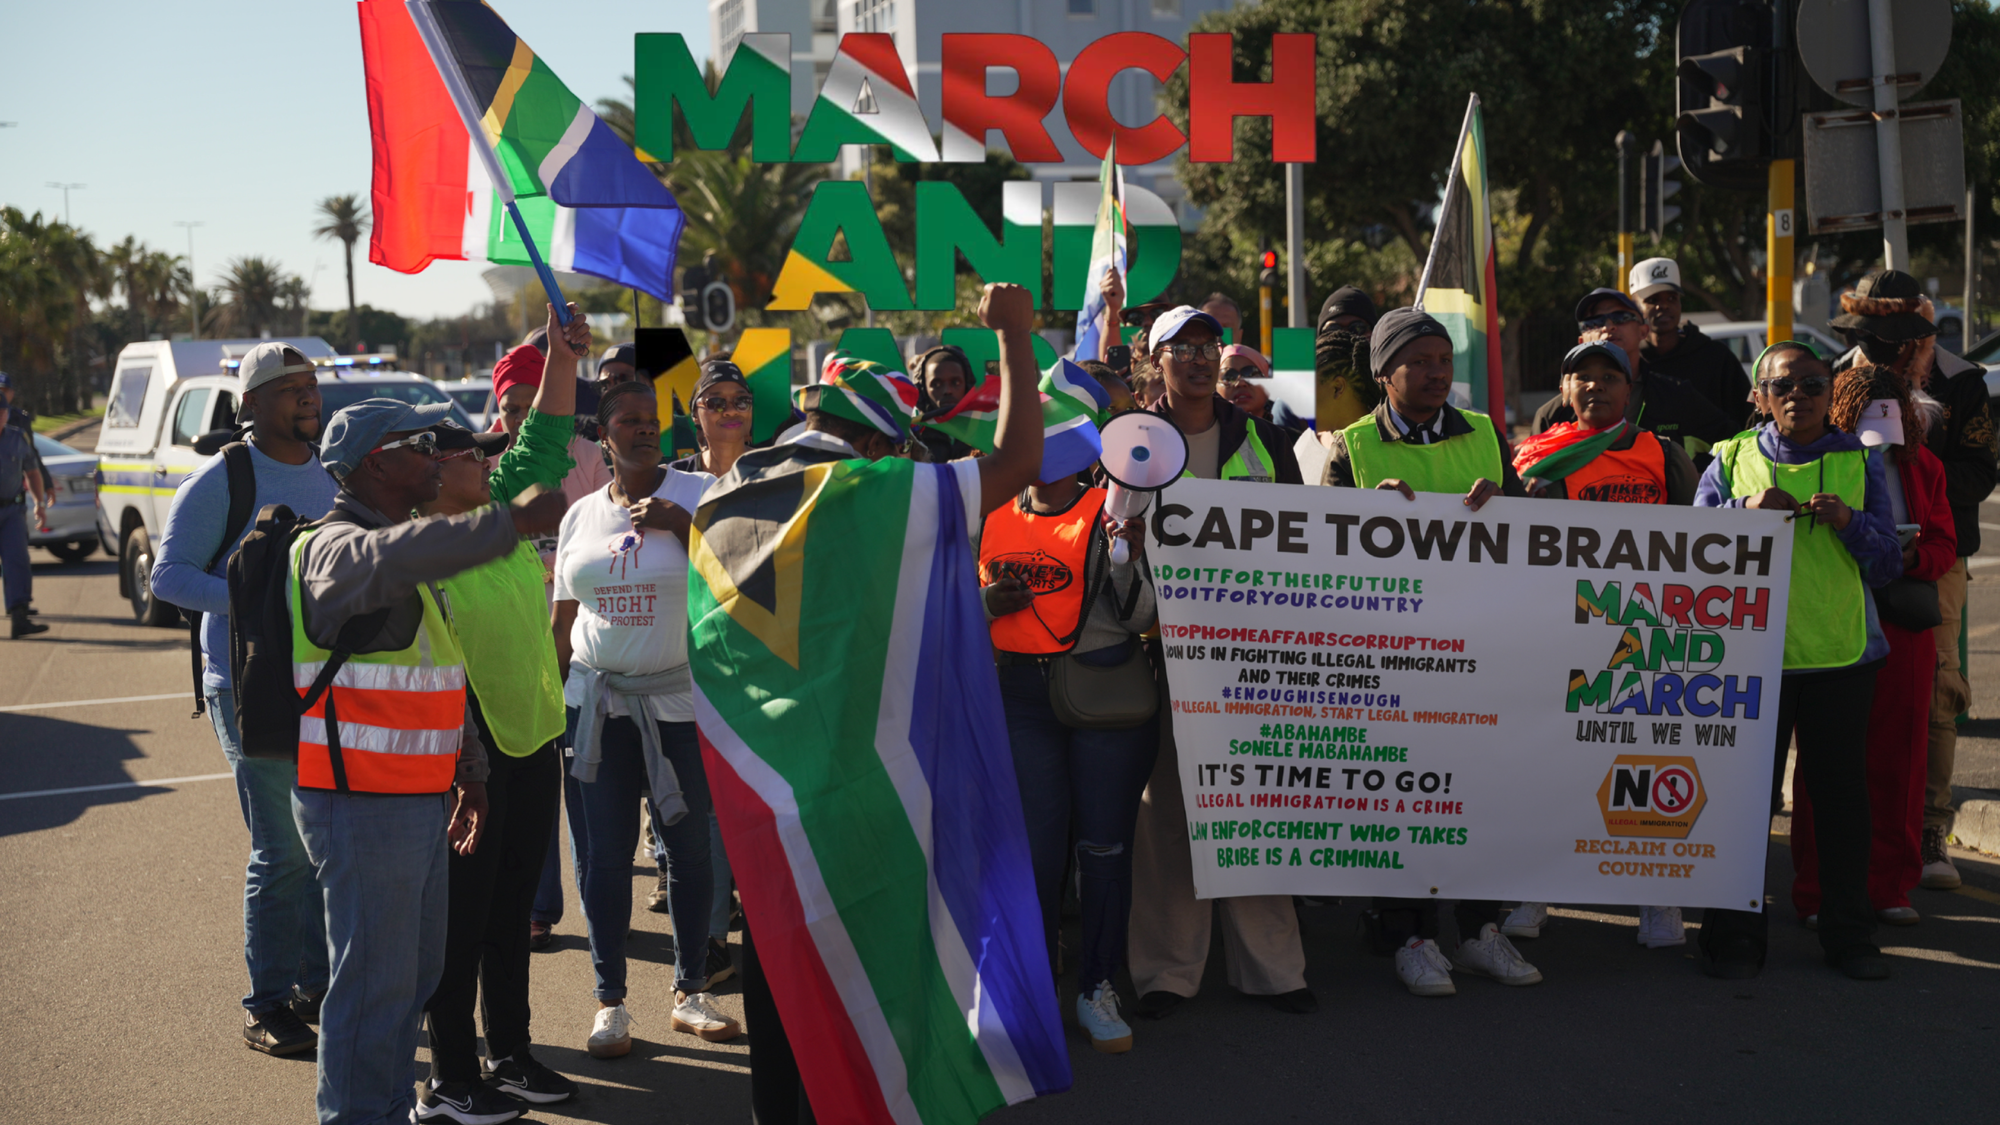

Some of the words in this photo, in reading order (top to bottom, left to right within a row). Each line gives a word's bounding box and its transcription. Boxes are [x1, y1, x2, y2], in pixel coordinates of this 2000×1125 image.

[1781, 213, 1790, 232] 8
[1652, 265, 1668, 278] Cal
[1583, 484, 1659, 503] MIKE'S
[1151, 503, 1309, 553] CAPE
[1325, 513, 1510, 564] TOWN
[1527, 524, 1774, 576] BRANCH
[593, 584, 632, 595] DEFEND
[635, 584, 656, 592] THE
[1153, 564, 1423, 594] #DOITFORTHEIRFUTURE
[597, 595, 657, 613] RIGHT
[1158, 584, 1423, 613] #DOITFORYOURCOUNTRY
[1575, 580, 1770, 631] MARCH
[610, 615, 655, 626] PROTEST
[1187, 646, 1205, 660] US
[1211, 647, 1227, 661] IN
[1231, 648, 1307, 665] FIGHTING
[1312, 652, 1375, 669] ILLEGAL
[1381, 656, 1477, 673] IMMIGRANTS
[1607, 627, 1725, 672] AND
[1238, 668, 1270, 684] AND
[1276, 671, 1320, 687] THEIR
[1326, 673, 1380, 689] CRIMES
[1222, 686, 1400, 708] #ENOUGHISENOUGH
[1565, 669, 1762, 719] MARCH
[1225, 702, 1317, 719] IMMIGRATION,
[1321, 707, 1364, 720] START
[1368, 709, 1409, 722] LEGAL
[1413, 711, 1498, 726] IMMIGRATION
[1260, 723, 1367, 743] #ABAHAMBE
[1576, 720, 1637, 743] UNTIL
[1652, 723, 1682, 745] WE
[1695, 724, 1736, 747] WIN
[1229, 739, 1293, 757] SONELE
[1299, 742, 1408, 762] MABAHAMBE
[1198, 764, 1245, 786] IT'S
[1255, 764, 1331, 789] TIME
[1342, 768, 1385, 791] TO
[1395, 771, 1452, 794] GO!
[1250, 793, 1368, 811] IMMIGRATION
[1374, 799, 1389, 812] IS
[1395, 799, 1405, 813] A
[1412, 800, 1463, 814] CRIME
[1212, 820, 1343, 840] ENFORCEMENT
[1350, 824, 1400, 842] WHO
[1407, 826, 1468, 845] TAKES
[1217, 847, 1259, 868] BRIBE
[1266, 847, 1282, 866] IS
[1289, 848, 1302, 866] A
[1309, 848, 1404, 869] CRIMINAL
[1574, 839, 1666, 856] RECLAIM
[1673, 843, 1716, 858] OUR
[1598, 861, 1695, 878] COUNTRY
